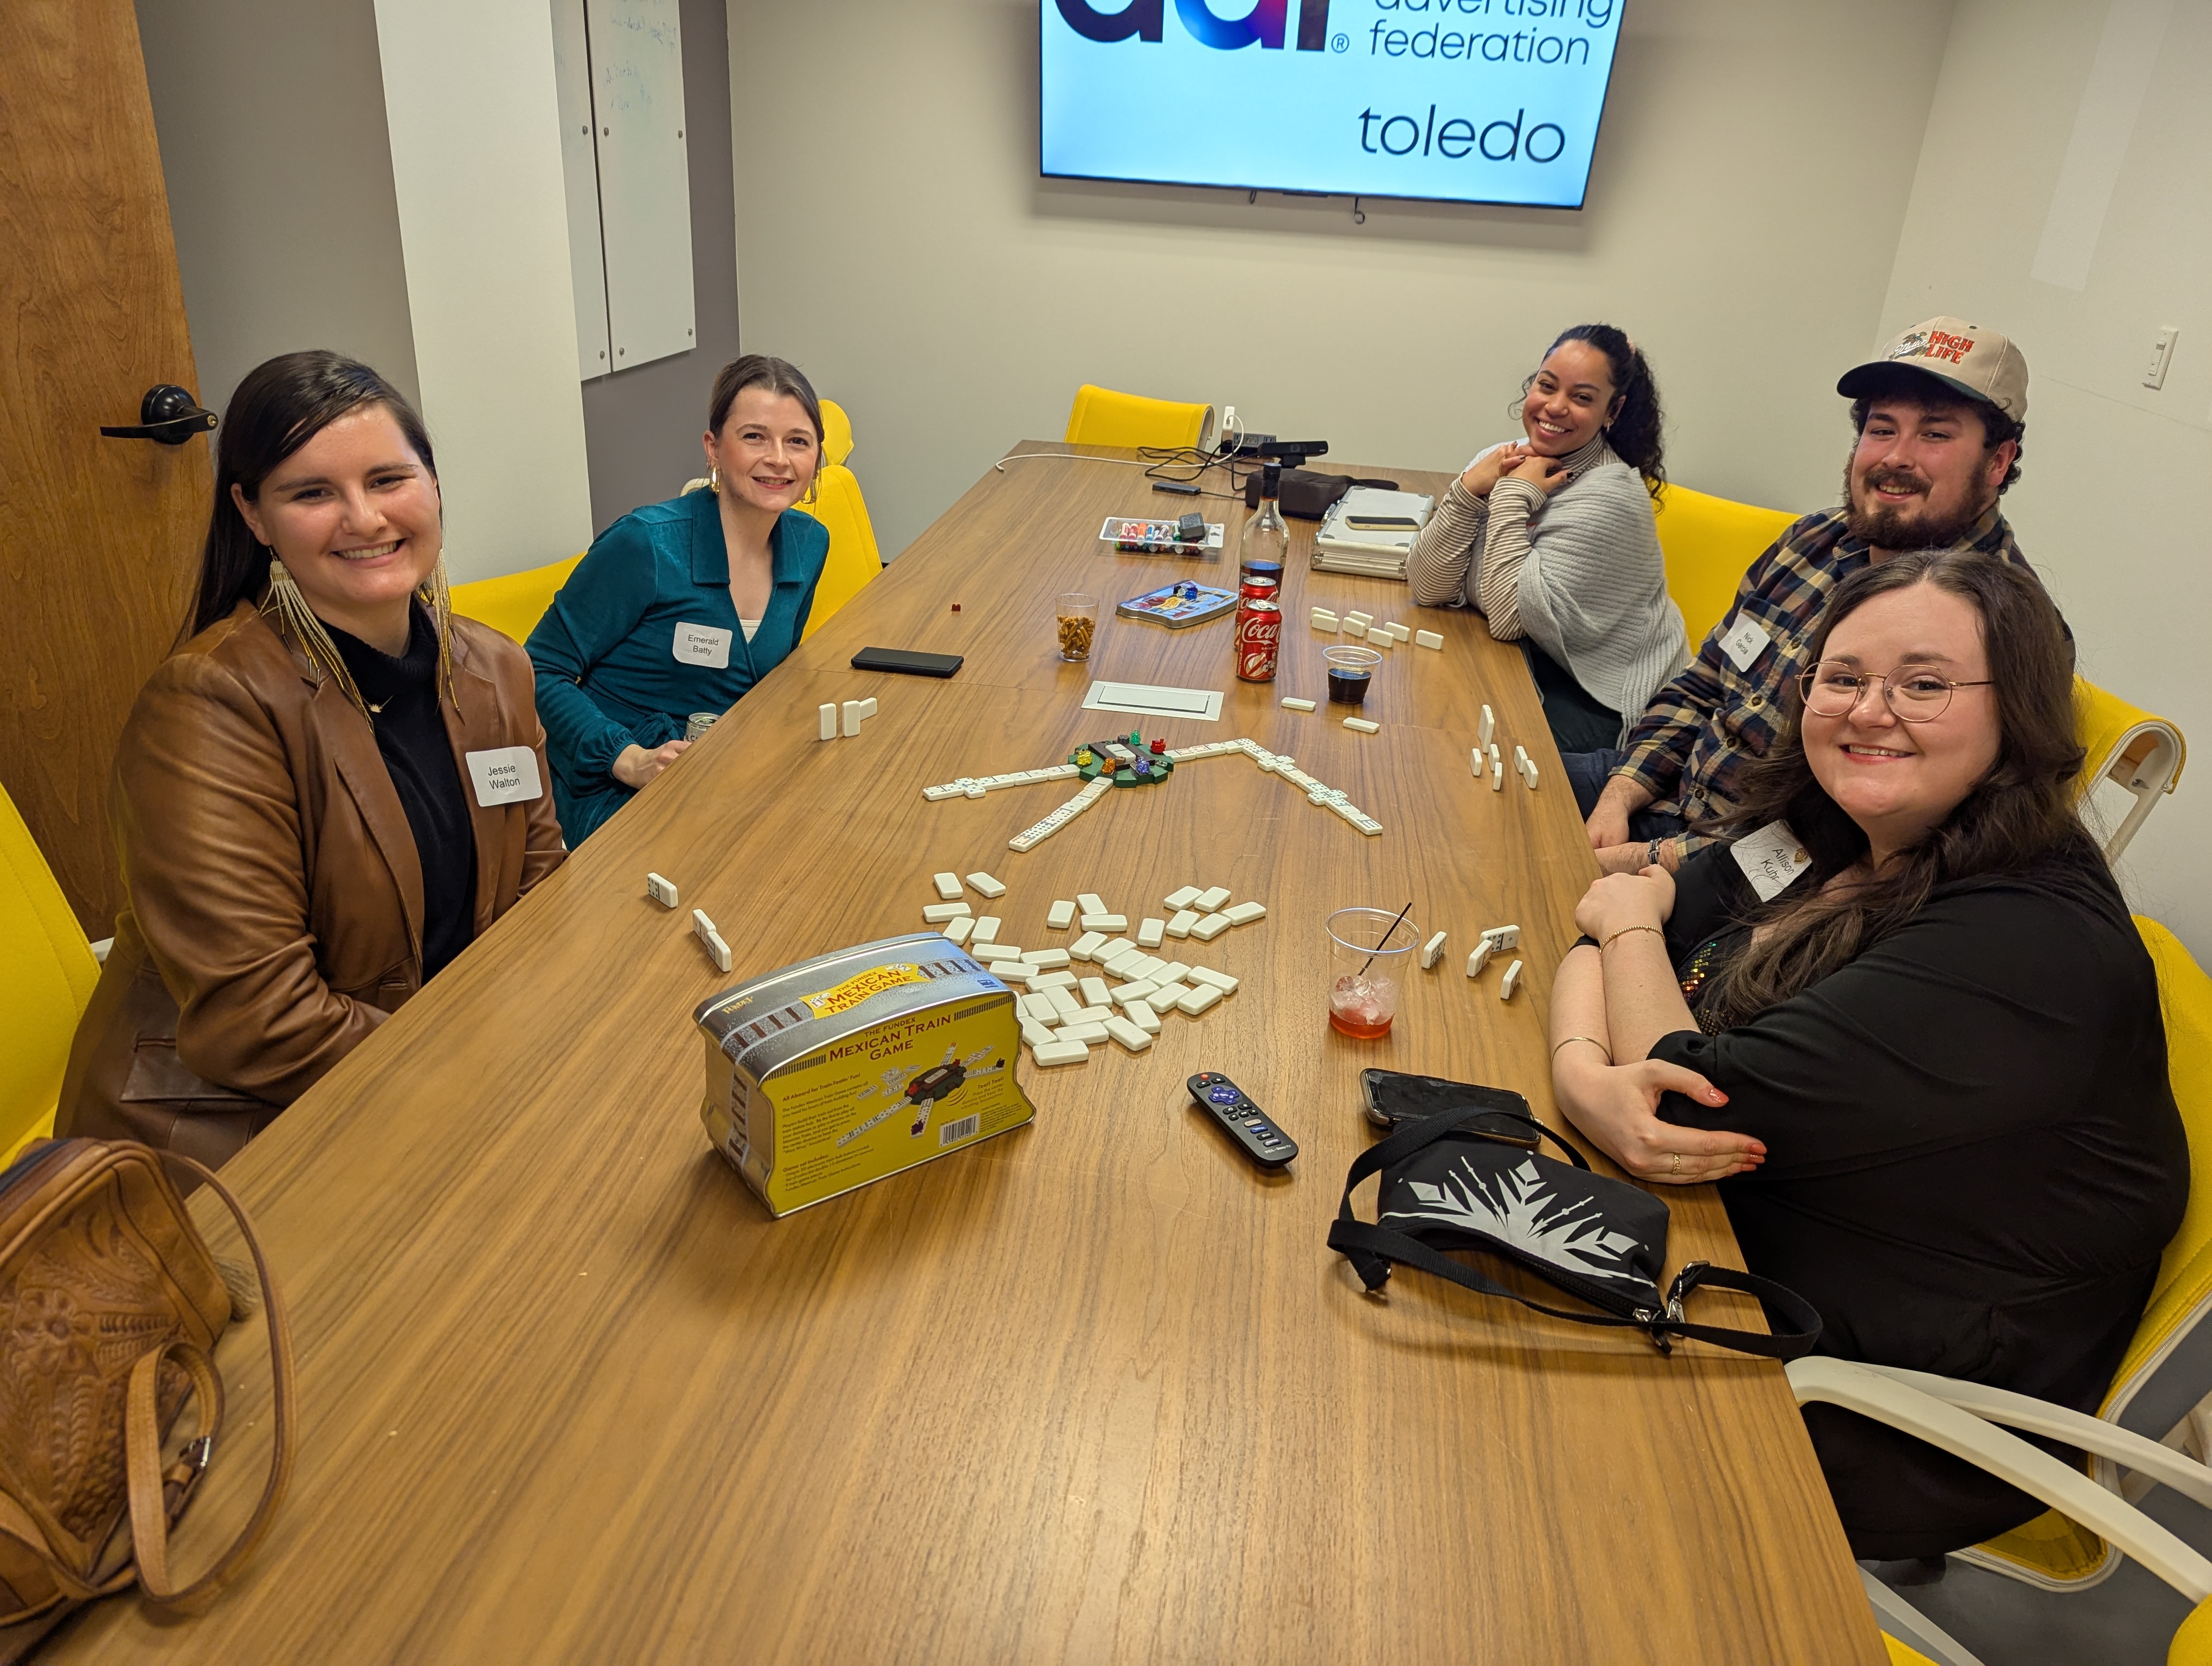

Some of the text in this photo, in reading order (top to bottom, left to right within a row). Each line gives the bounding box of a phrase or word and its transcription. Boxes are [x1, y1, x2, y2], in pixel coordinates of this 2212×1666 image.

[1369, 18, 1590, 66] federation
[1357, 104, 1566, 163] toledo
[1894, 338, 1928, 357] Miller
[1927, 330, 1975, 353] HIGH
[1924, 344, 1965, 364] LIFE
[687, 634, 719, 646] Emerald
[1744, 632, 1754, 644] Nick
[692, 645, 712, 656] Batty
[488, 764, 516, 776] Jessie
[489, 778, 521, 790] Walton
[1760, 858, 1780, 881] Kuhr
[1772, 848, 1795, 876] Allison
[827, 970, 902, 1005] MEXICAN
[836, 971, 878, 992] THE FUNDEX
[825, 976, 913, 1013] TRAIN GAME
[864, 1016, 916, 1037] THE FUNDEX
[829, 1014, 951, 1061] MEXICAN TRAIN
[870, 1039, 914, 1060] GAME
[978, 1076, 1004, 1090] Toot! Toot!
[790, 1089, 811, 1099] Aboard
